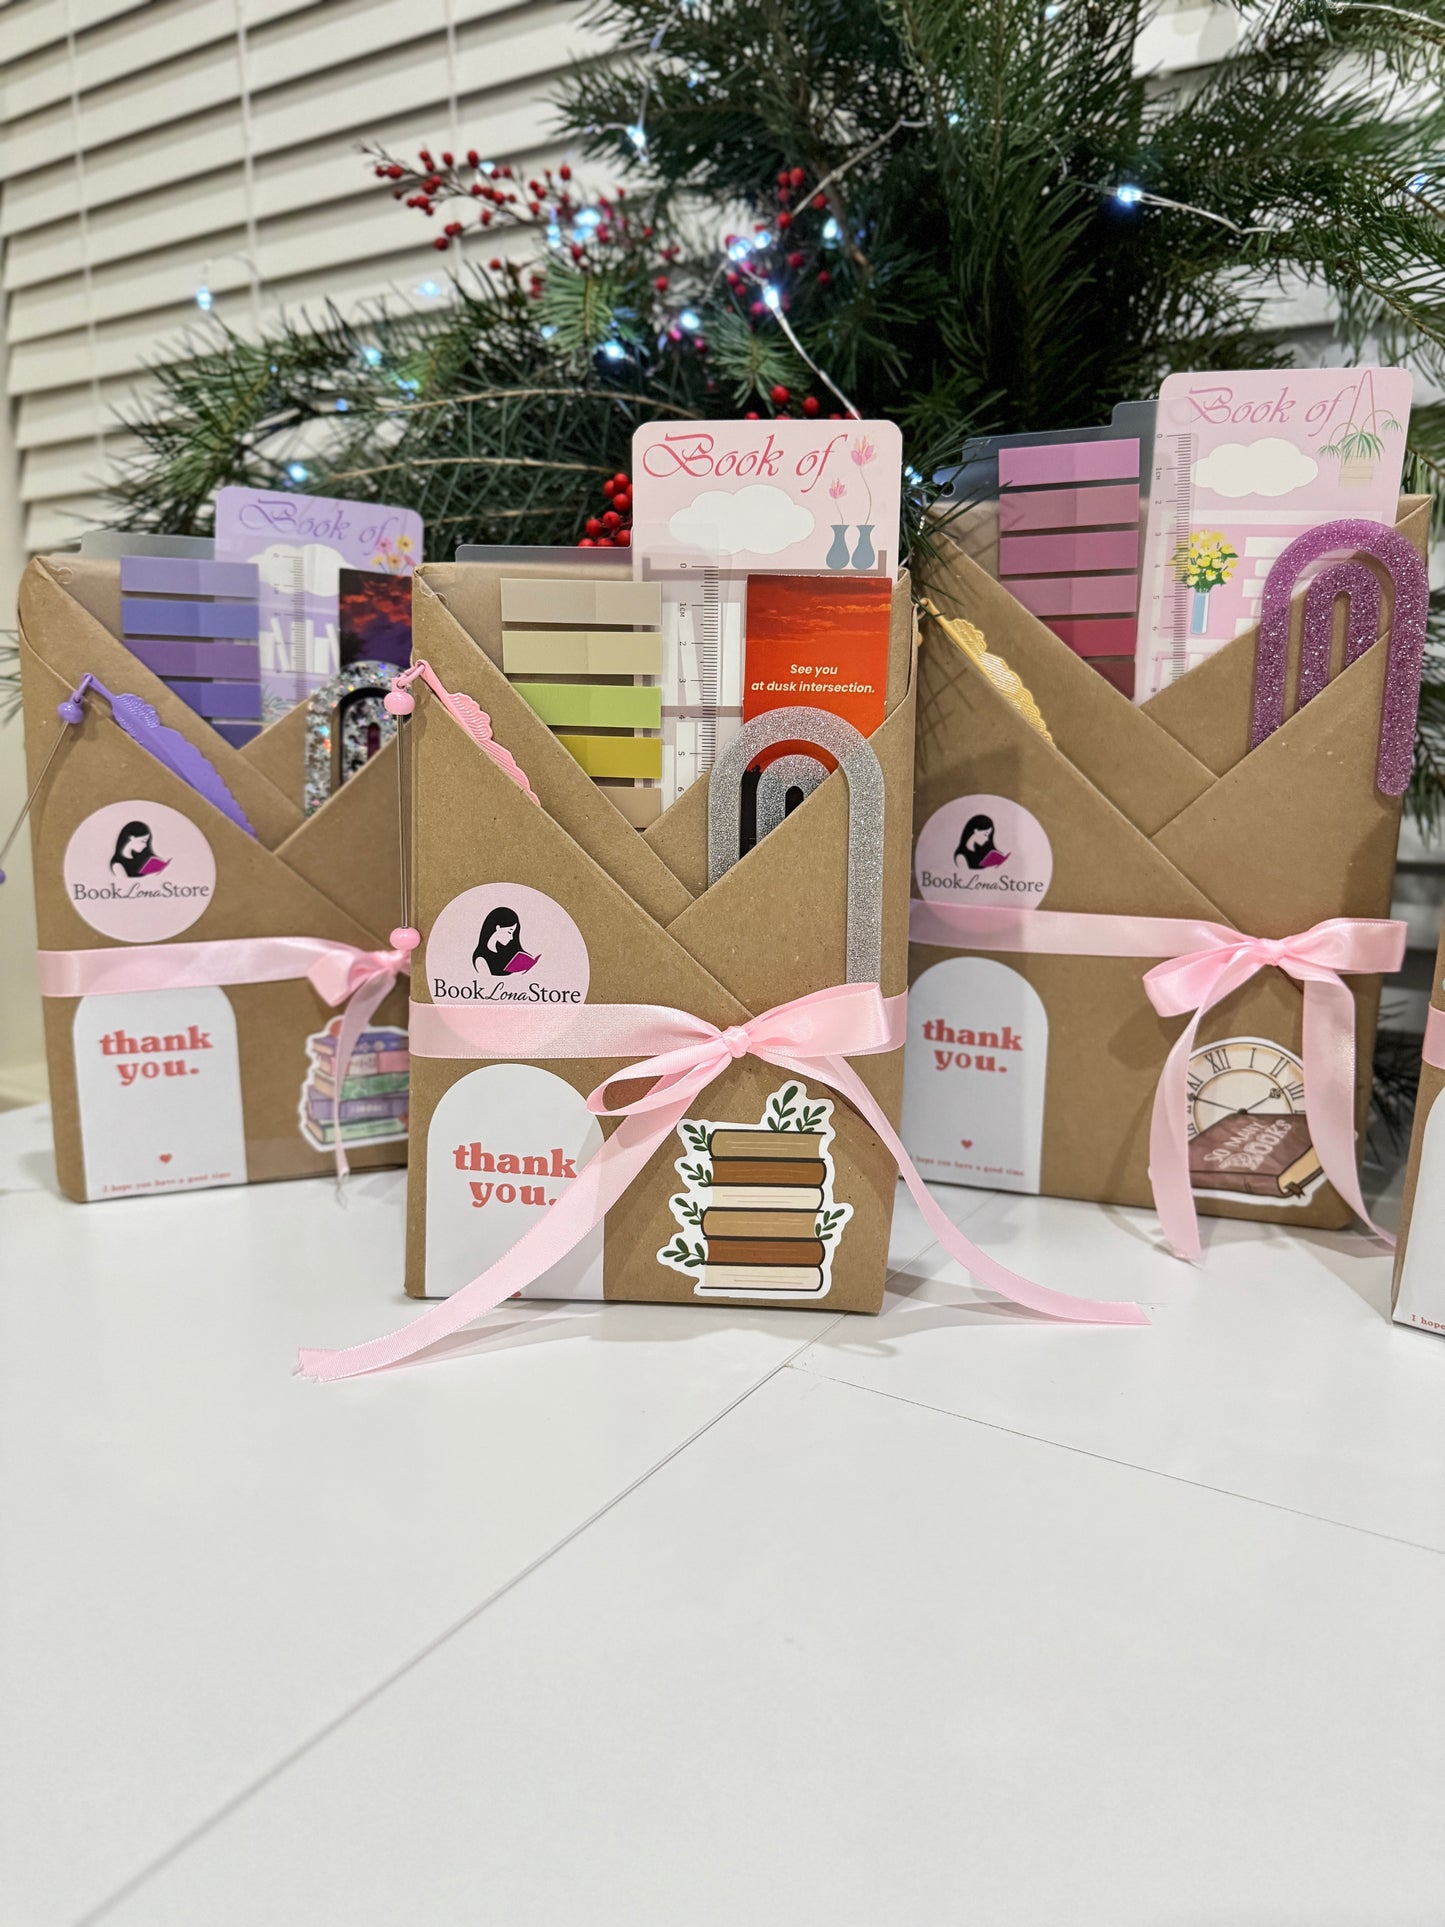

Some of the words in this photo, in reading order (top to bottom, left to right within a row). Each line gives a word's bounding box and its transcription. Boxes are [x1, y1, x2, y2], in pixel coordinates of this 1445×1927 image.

[1186, 387, 1296, 424] Book
[1305, 385, 1356, 437] of
[642, 433, 784, 478] Book
[795, 433, 848, 494] of
[239, 498, 350, 541] Book
[359, 516, 399, 556] of
[790, 664, 812, 675] See
[815, 666, 838, 677] you
[751, 681, 765, 691] at
[767, 681, 797, 691] dusk
[799, 681, 875, 693] intersection.
[98, 1025, 213, 1056] thank
[922, 1018, 1023, 1051] thank
[117, 1059, 200, 1086] you.
[934, 1050, 1008, 1073] you.
[1203, 1148, 1231, 1162] SO
[1223, 1121, 1266, 1147] MANY
[453, 1142, 577, 1178] thank
[1411, 1314, 1416, 1322] I
